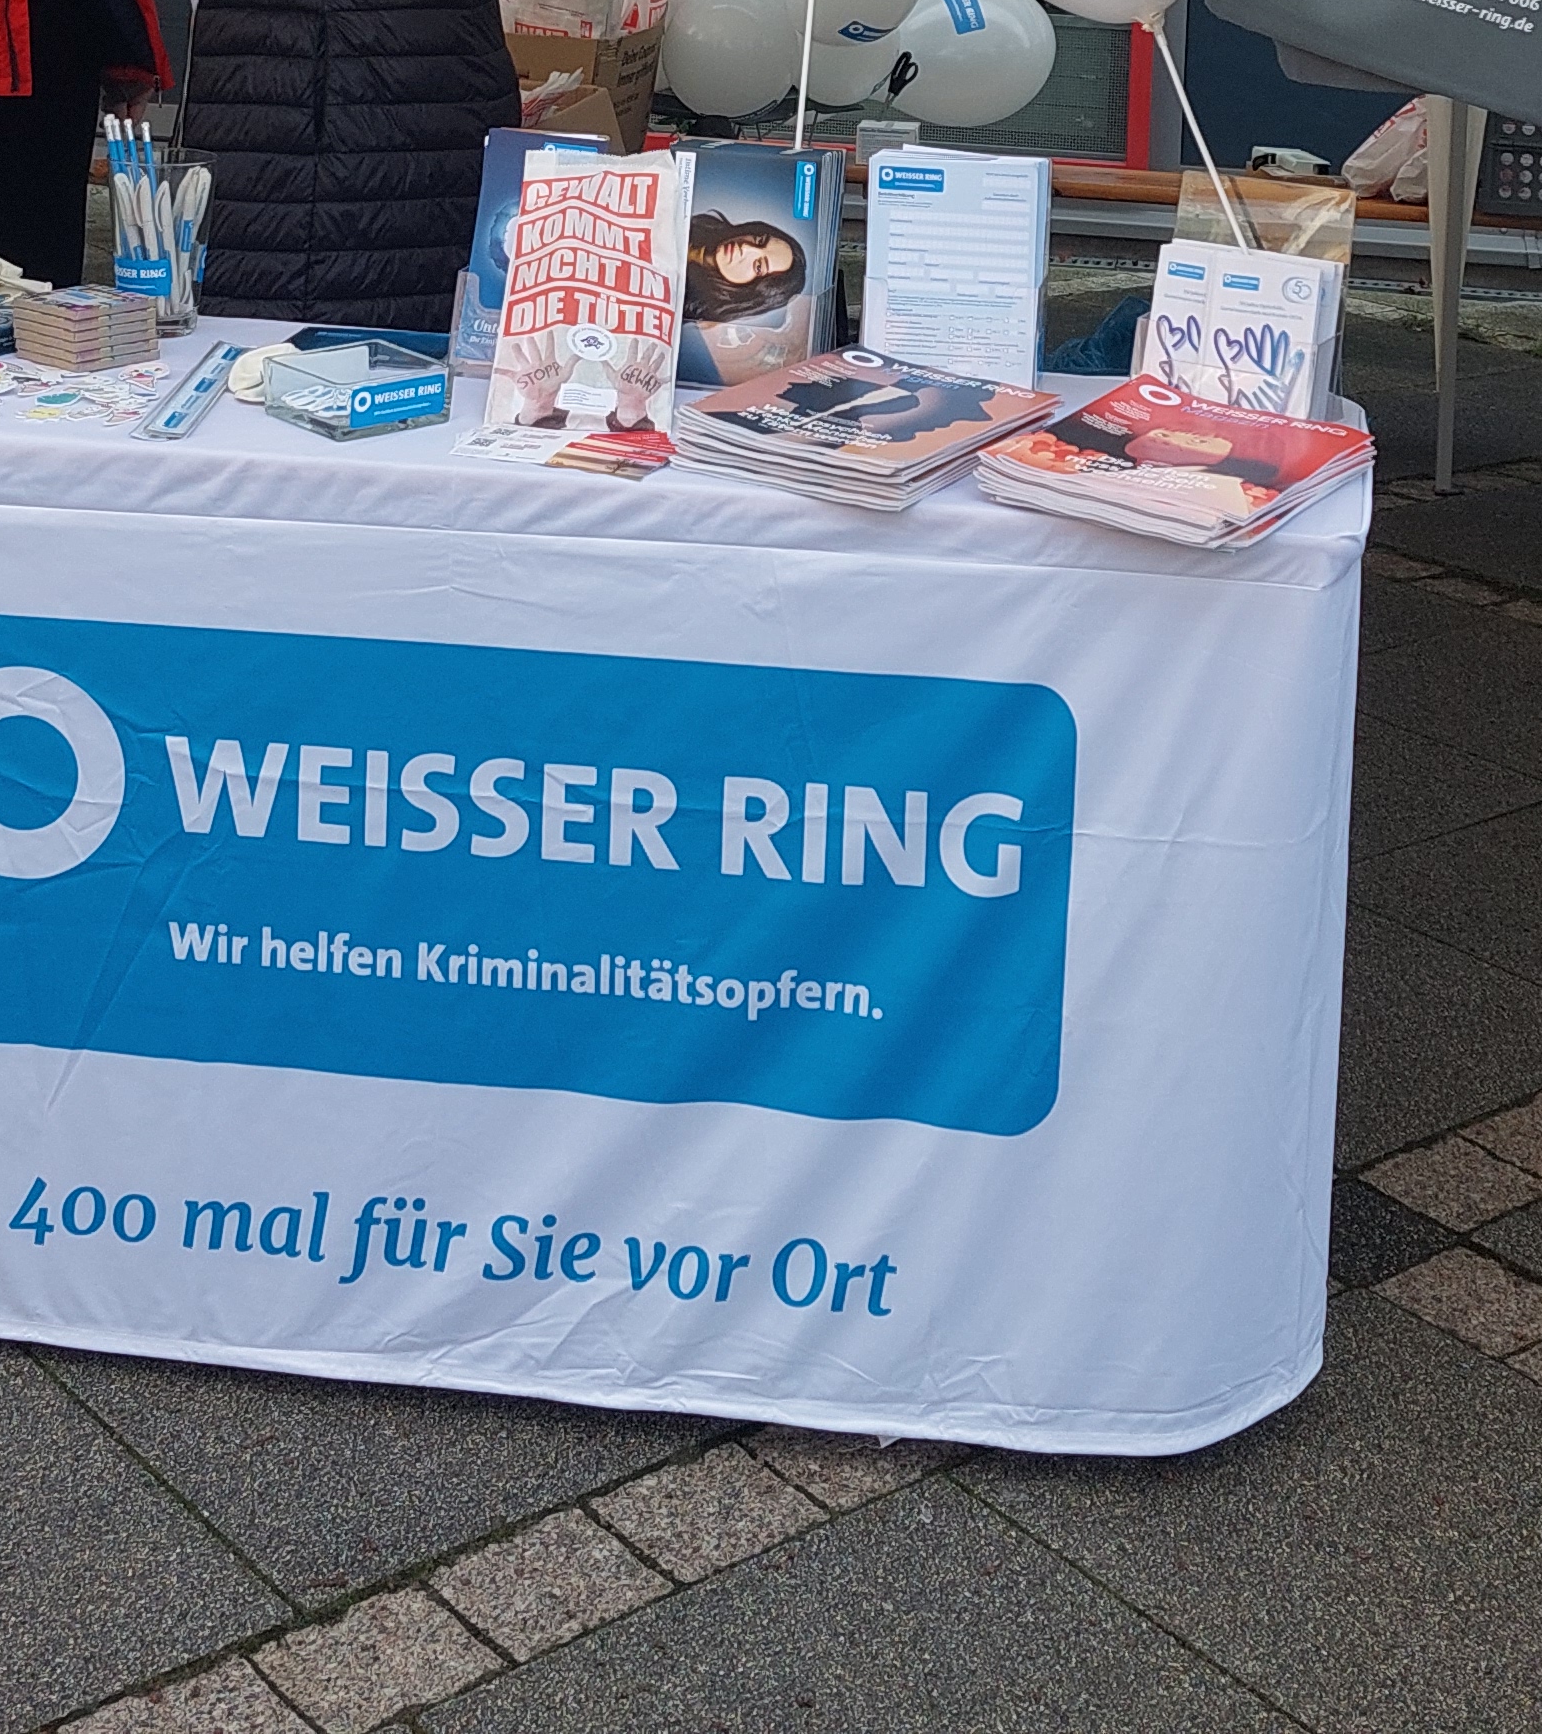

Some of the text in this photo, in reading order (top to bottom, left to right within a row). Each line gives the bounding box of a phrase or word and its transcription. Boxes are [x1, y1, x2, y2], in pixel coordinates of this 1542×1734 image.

[525, 172, 652, 215] GEWALT
[521, 208, 645, 258] KOMMT
[140, 268, 166, 279] RING
[514, 248, 665, 298] NICHT IN
[510, 291, 566, 334] DIE
[574, 291, 670, 343] TÜTE!
[375, 383, 442, 405] WEISSER RING
[517, 361, 561, 390] STOPP
[892, 362, 1036, 399] WEISSER RING
[1191, 399, 1348, 437] WEISSER RING
[165, 735, 1025, 899] WEISSER RING
[168, 921, 884, 1021] Wir helfen Kriminalitätsopfern.
[8, 1177, 898, 1317] 400 mal für Sie vor Ort
